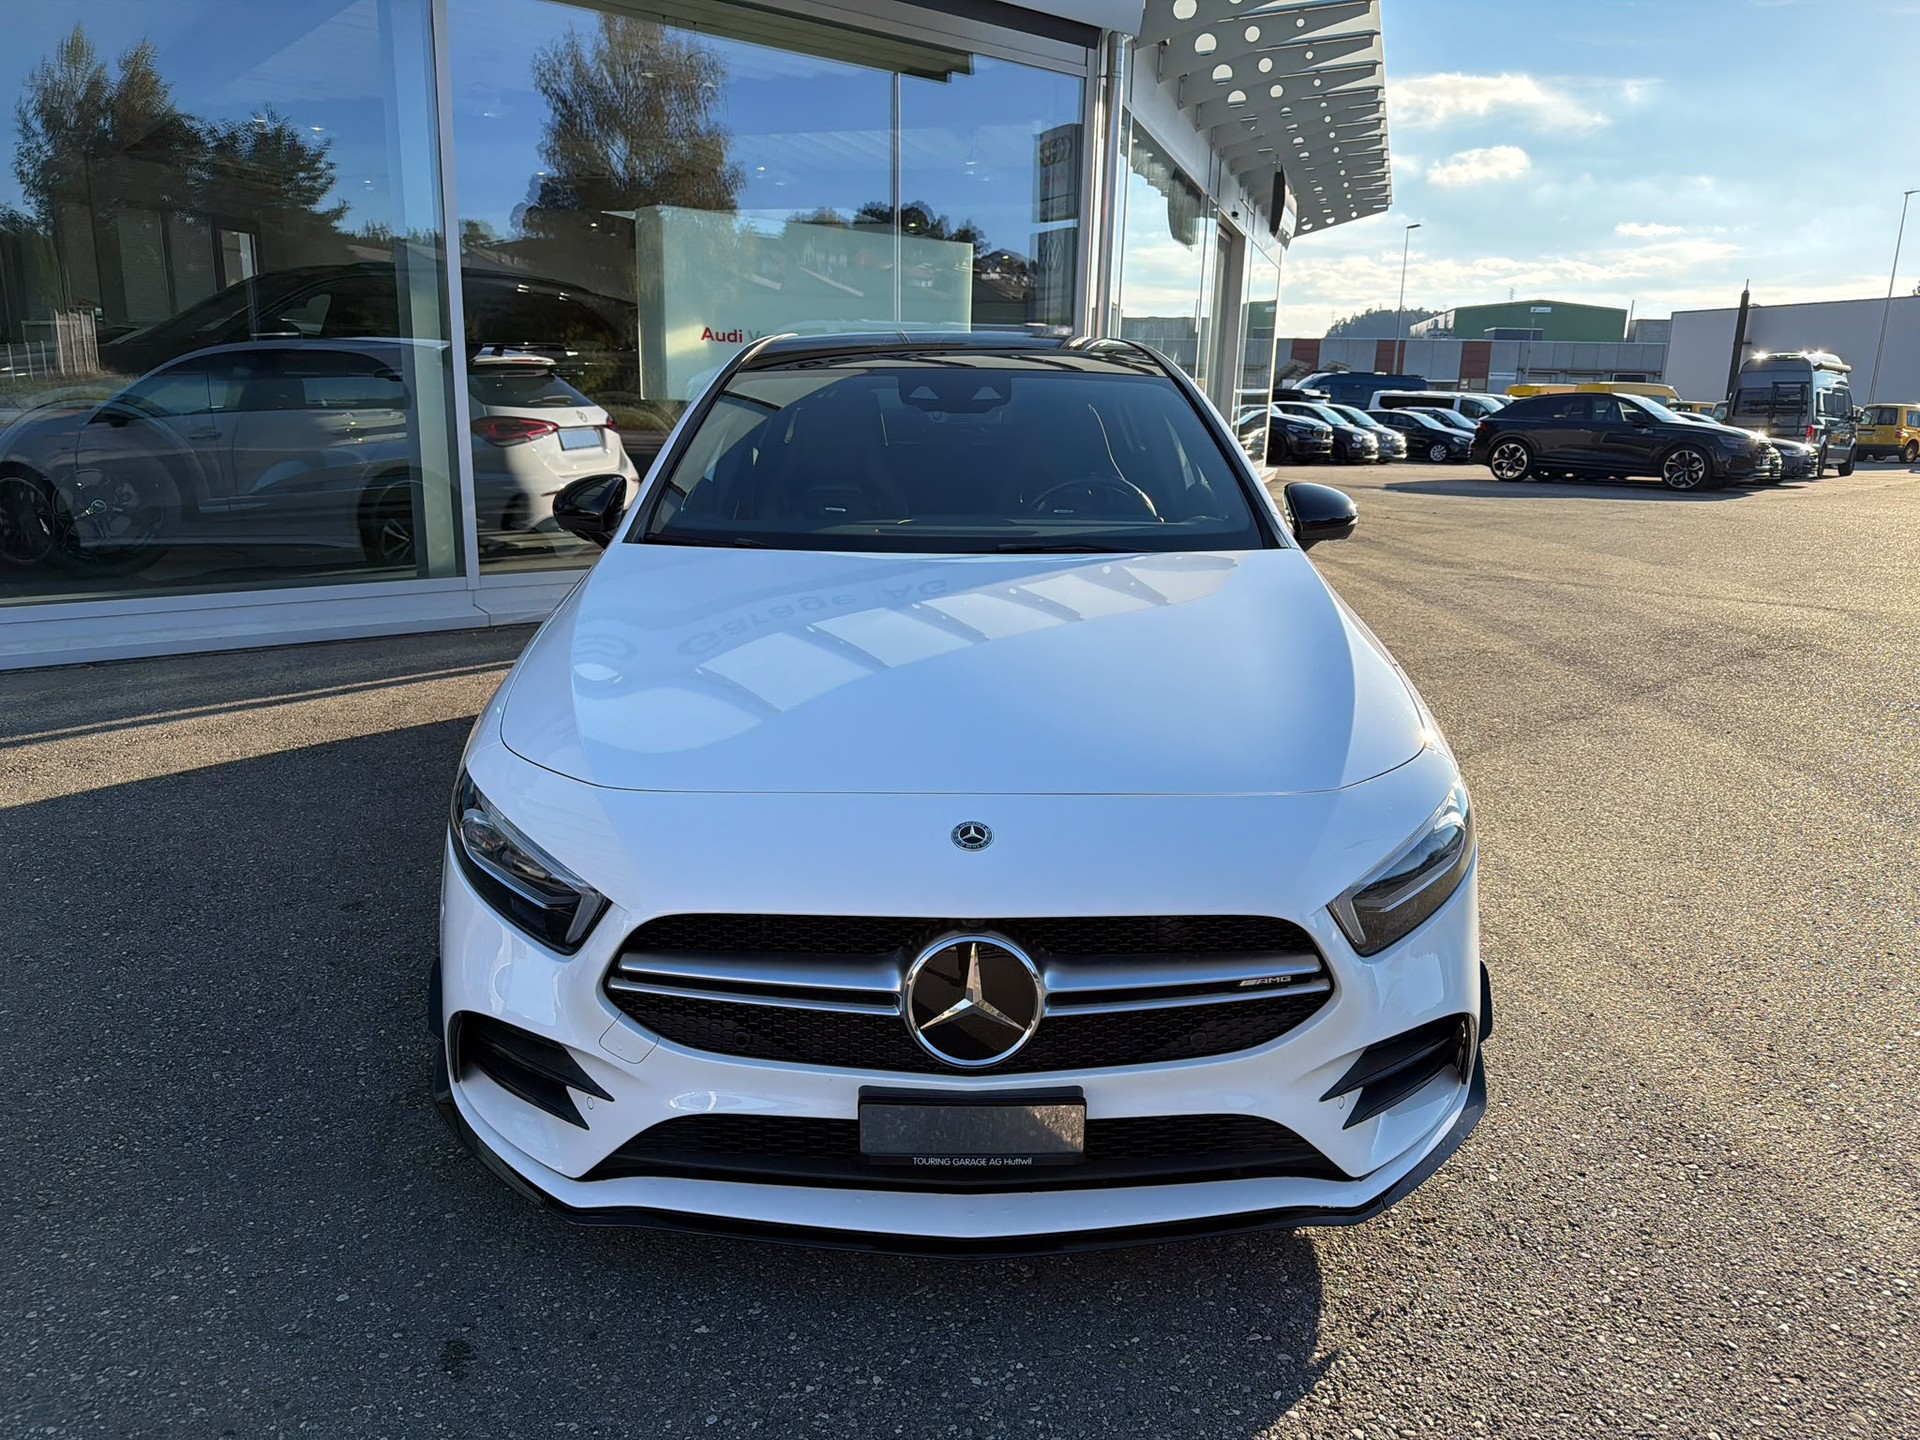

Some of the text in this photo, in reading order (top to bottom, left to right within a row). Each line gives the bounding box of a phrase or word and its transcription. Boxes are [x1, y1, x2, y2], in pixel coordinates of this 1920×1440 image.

[701, 326, 743, 344] Audi
[1255, 976, 1291, 985] AMG
[912, 1157, 1032, 1166] TOURING GARAGE AG Huttwil
